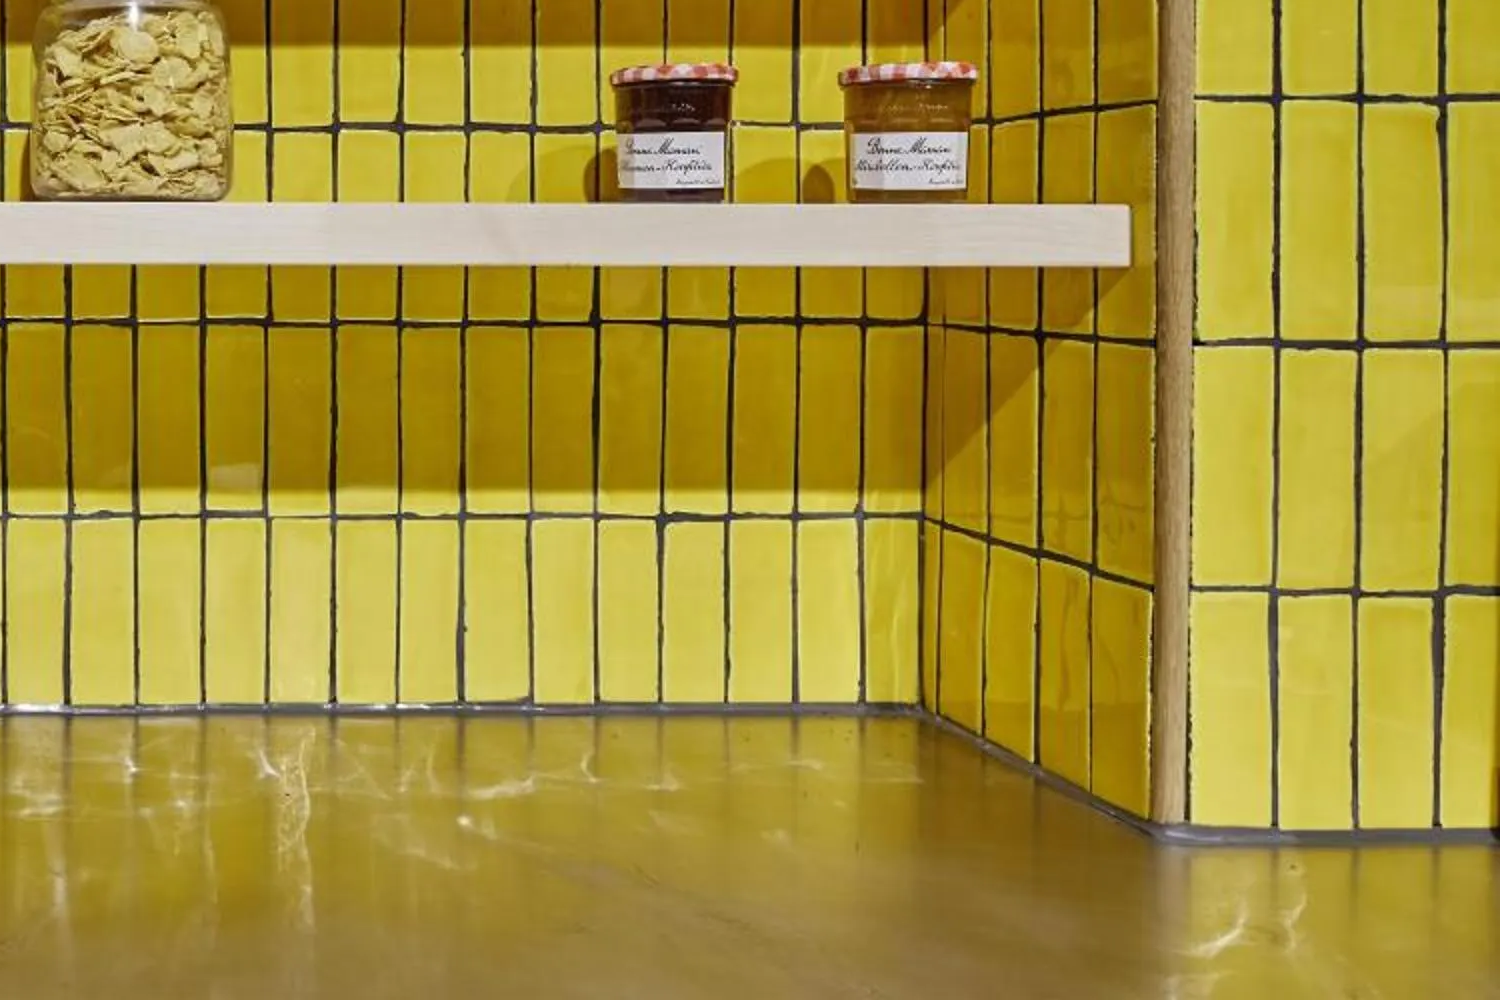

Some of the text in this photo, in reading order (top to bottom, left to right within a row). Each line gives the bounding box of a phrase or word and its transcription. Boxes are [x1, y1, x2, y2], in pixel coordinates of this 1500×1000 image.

[654, 137, 702, 155] Maman
[866, 135, 952, 155] Bonne Maman
